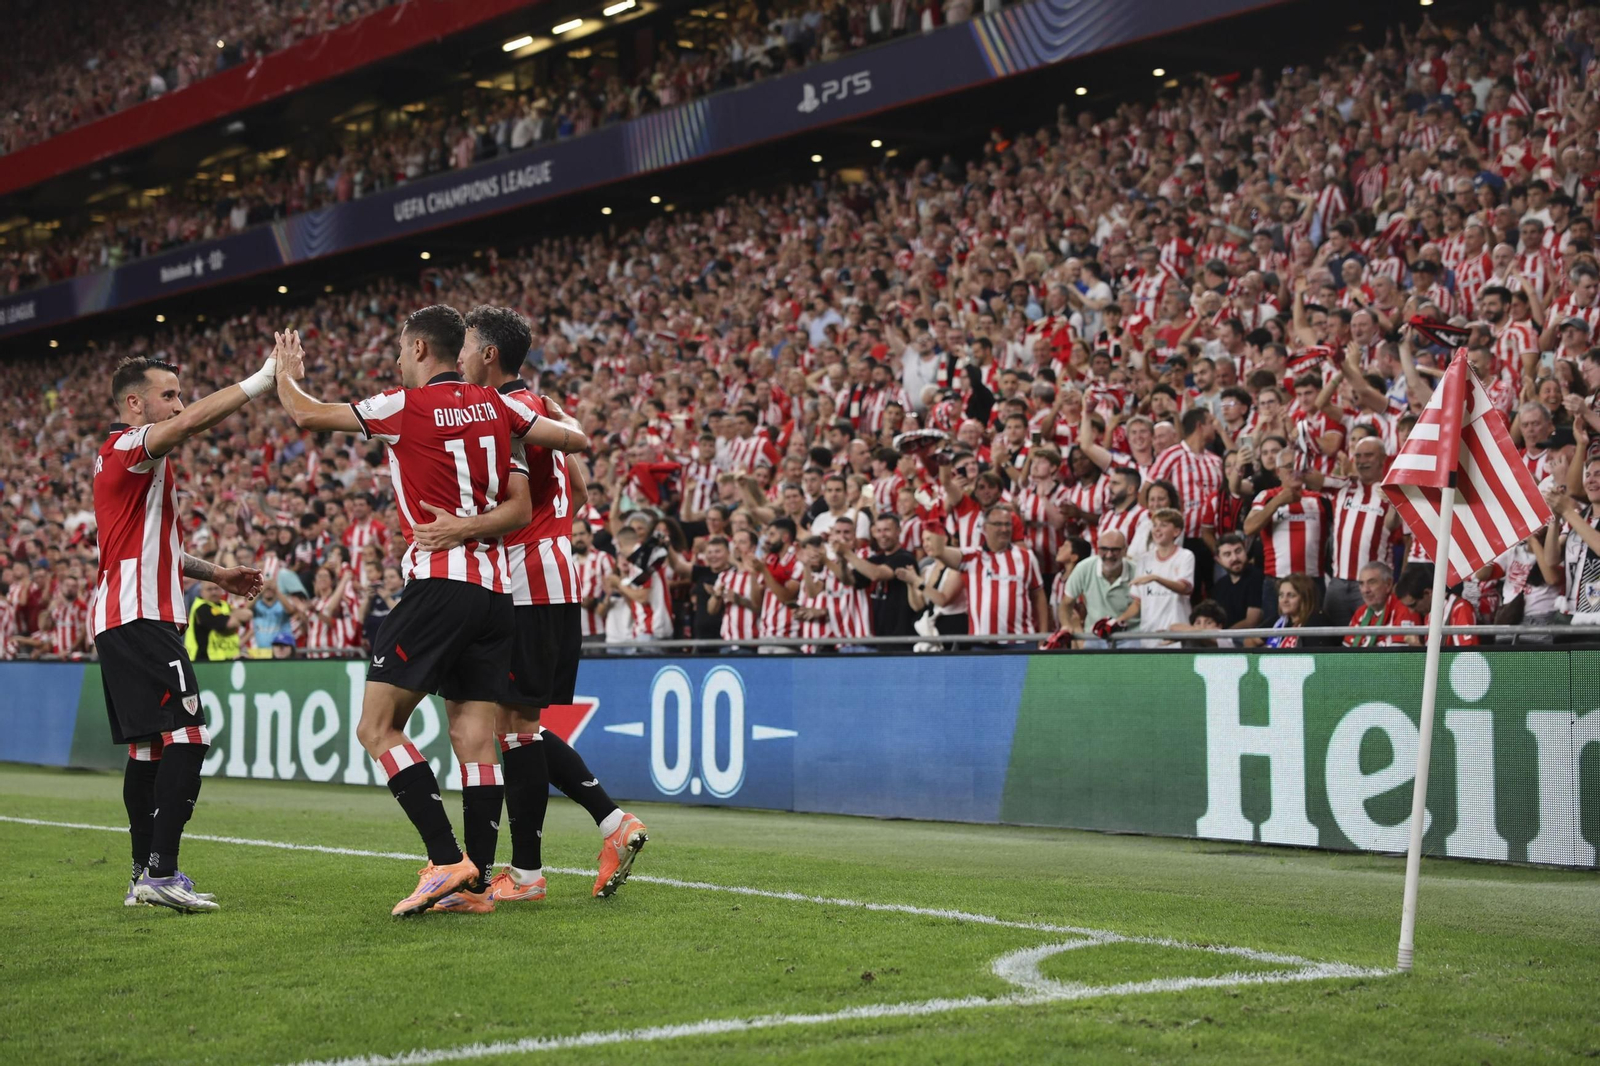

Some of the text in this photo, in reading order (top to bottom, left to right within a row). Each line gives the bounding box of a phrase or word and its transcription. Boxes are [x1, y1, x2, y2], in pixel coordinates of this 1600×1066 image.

[821, 70, 872, 103] PS5
[393, 160, 553, 222] UEFA CHAMPIONS LEAGUE
[433, 401, 498, 427] GURUZETA
[444, 435, 500, 517] 11
[168, 659, 187, 692] 7
[650, 664, 746, 798] 0.0
